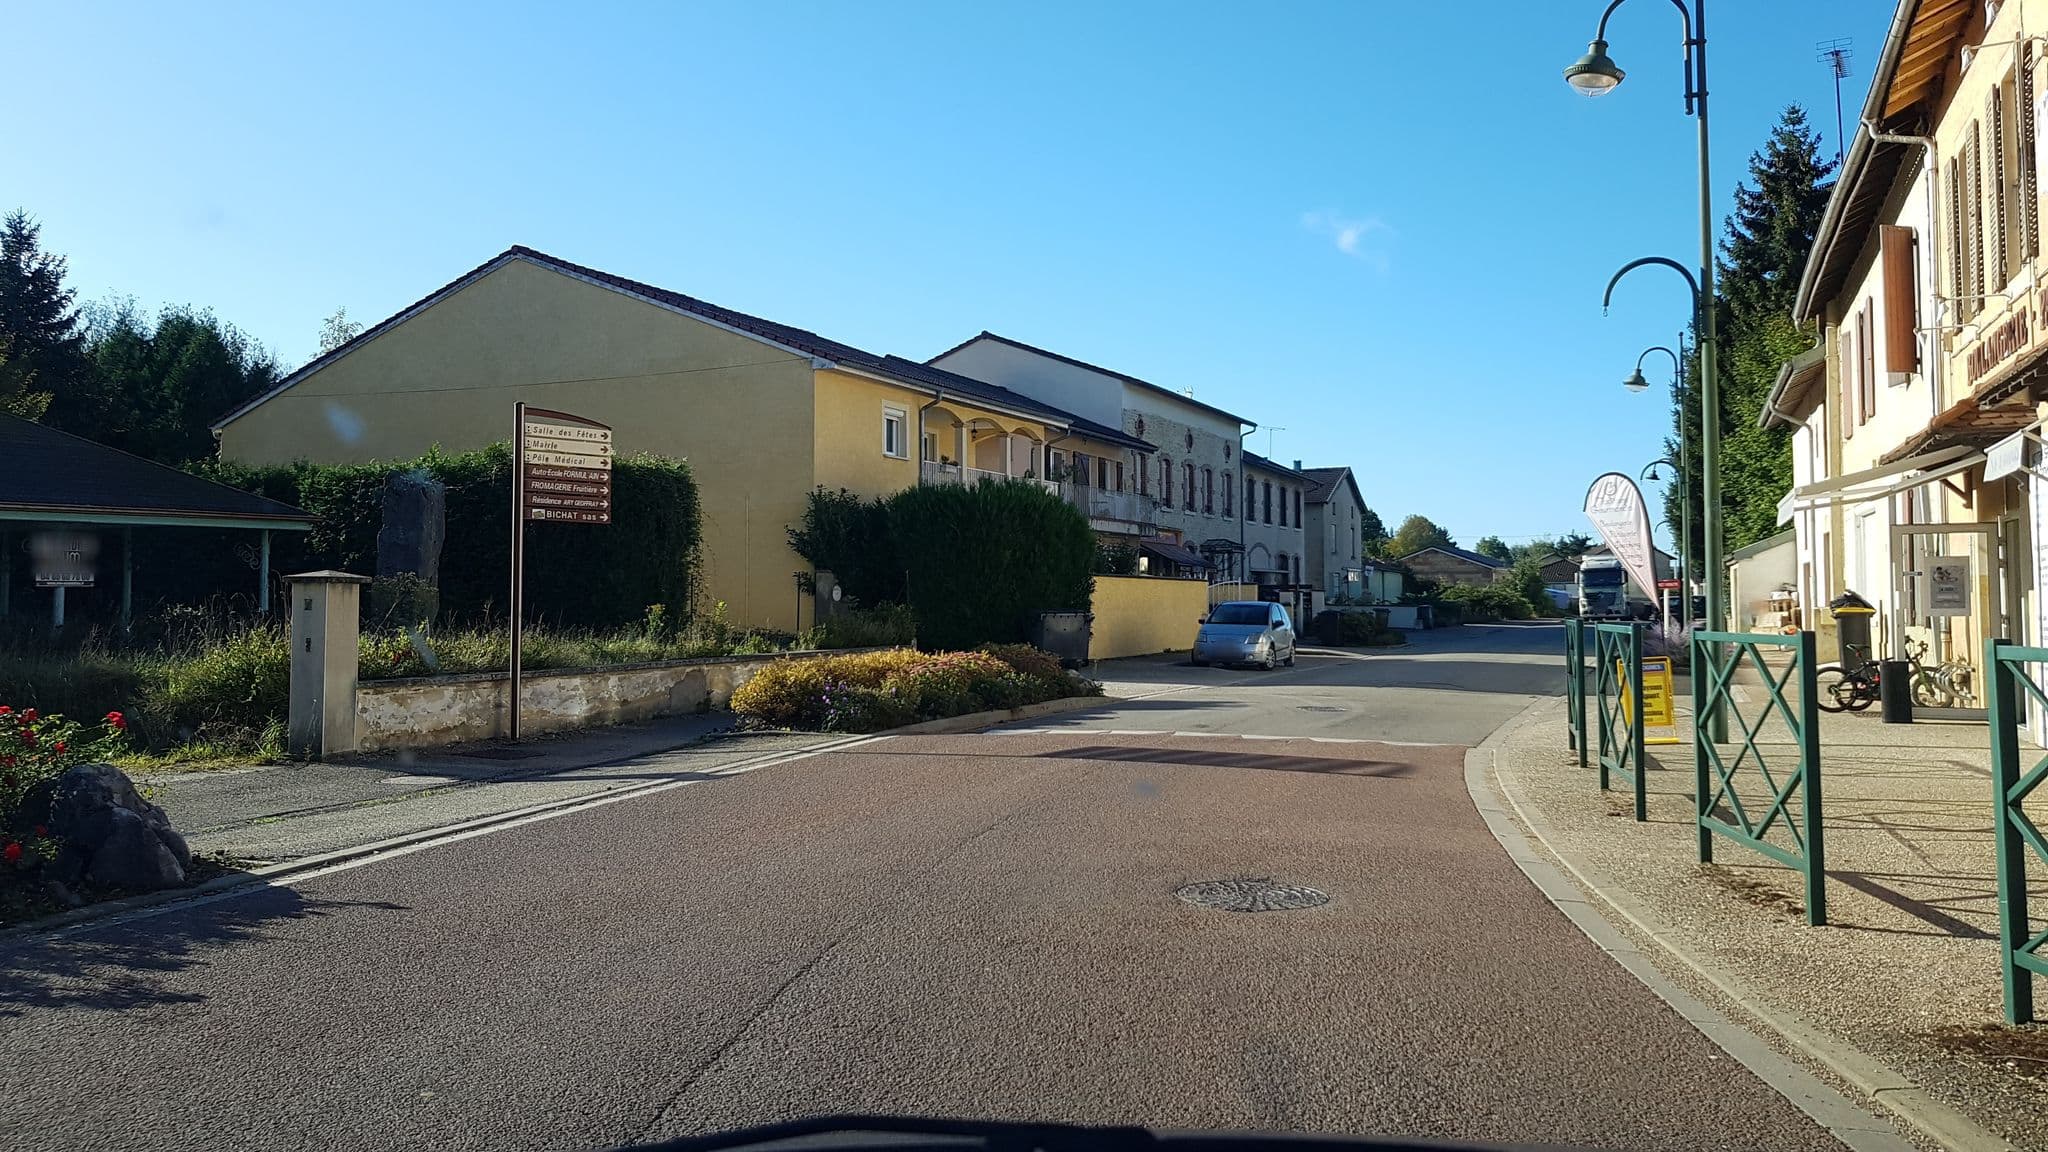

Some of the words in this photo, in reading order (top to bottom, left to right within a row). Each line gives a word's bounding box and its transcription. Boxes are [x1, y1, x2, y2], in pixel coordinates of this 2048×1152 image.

[533, 426, 553, 435] Salle
[576, 430, 597, 439] Fêtes
[532, 440, 558, 449] Mairie
[532, 453, 549, 462] Pôle
[554, 456, 586, 465] Médical
[531, 481, 572, 491] FROMAGERIE
[531, 495, 562, 505] Résidence
[546, 510, 578, 519] BICHAT
